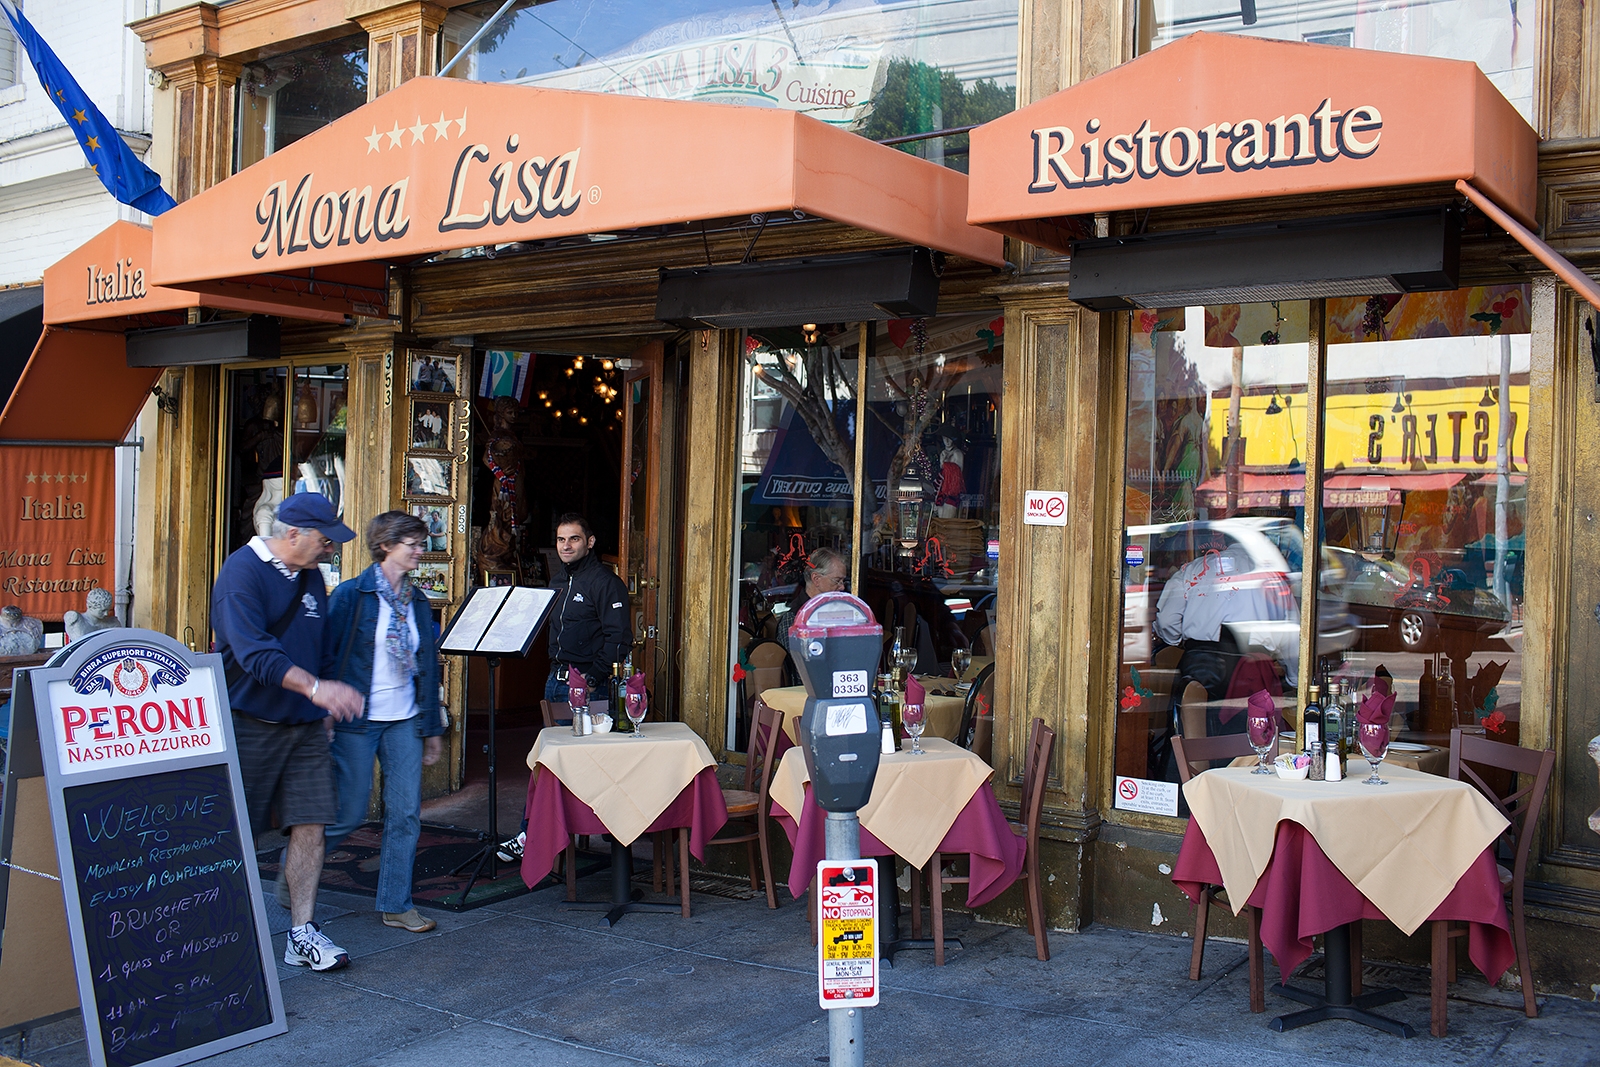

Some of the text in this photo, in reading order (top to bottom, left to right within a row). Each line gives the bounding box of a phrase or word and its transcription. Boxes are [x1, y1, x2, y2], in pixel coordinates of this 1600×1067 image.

[696, 43, 760, 90] LISA
[761, 46, 788, 93] 3
[786, 79, 856, 107] Cuisine
[1028, 97, 1383, 194] Ristorante
[251, 172, 411, 260] Mona
[438, 133, 583, 234] Lisa
[86, 256, 148, 306] Italia
[384, 353, 393, 407] 353
[457, 399, 471, 466] 353
[20, 494, 87, 521] Italia
[1029, 498, 1044, 510] NO
[457, 505, 466, 534] 353
[0, 547, 107, 568] Mona Lisa
[2, 575, 101, 597] Ristorante
[80, 648, 177, 678] BIRRA SUPERIORE D'ITALIA
[85, 679, 100, 693] DAL
[160, 671, 179, 685] 1846
[833, 684, 866, 695] 03350
[839, 673, 859, 683] 363
[60, 696, 211, 746] PERONI
[67, 732, 211, 764] NASTRO AZZURRO
[83, 794, 219, 842] WELCOME
[137, 829, 170, 848] TO
[149, 829, 231, 864] RESTAURANT
[89, 882, 144, 908] ENJOY
[146, 874, 157, 892] A
[106, 886, 220, 939] BRUSCHETTA
[823, 907, 871, 919] NO STOPPING
[155, 919, 181, 943] OR
[99, 931, 240, 983] 1 GLASS OF MOSCATO
[852, 950, 872, 958] SATURDAY
[174, 983, 185, 996] 3
